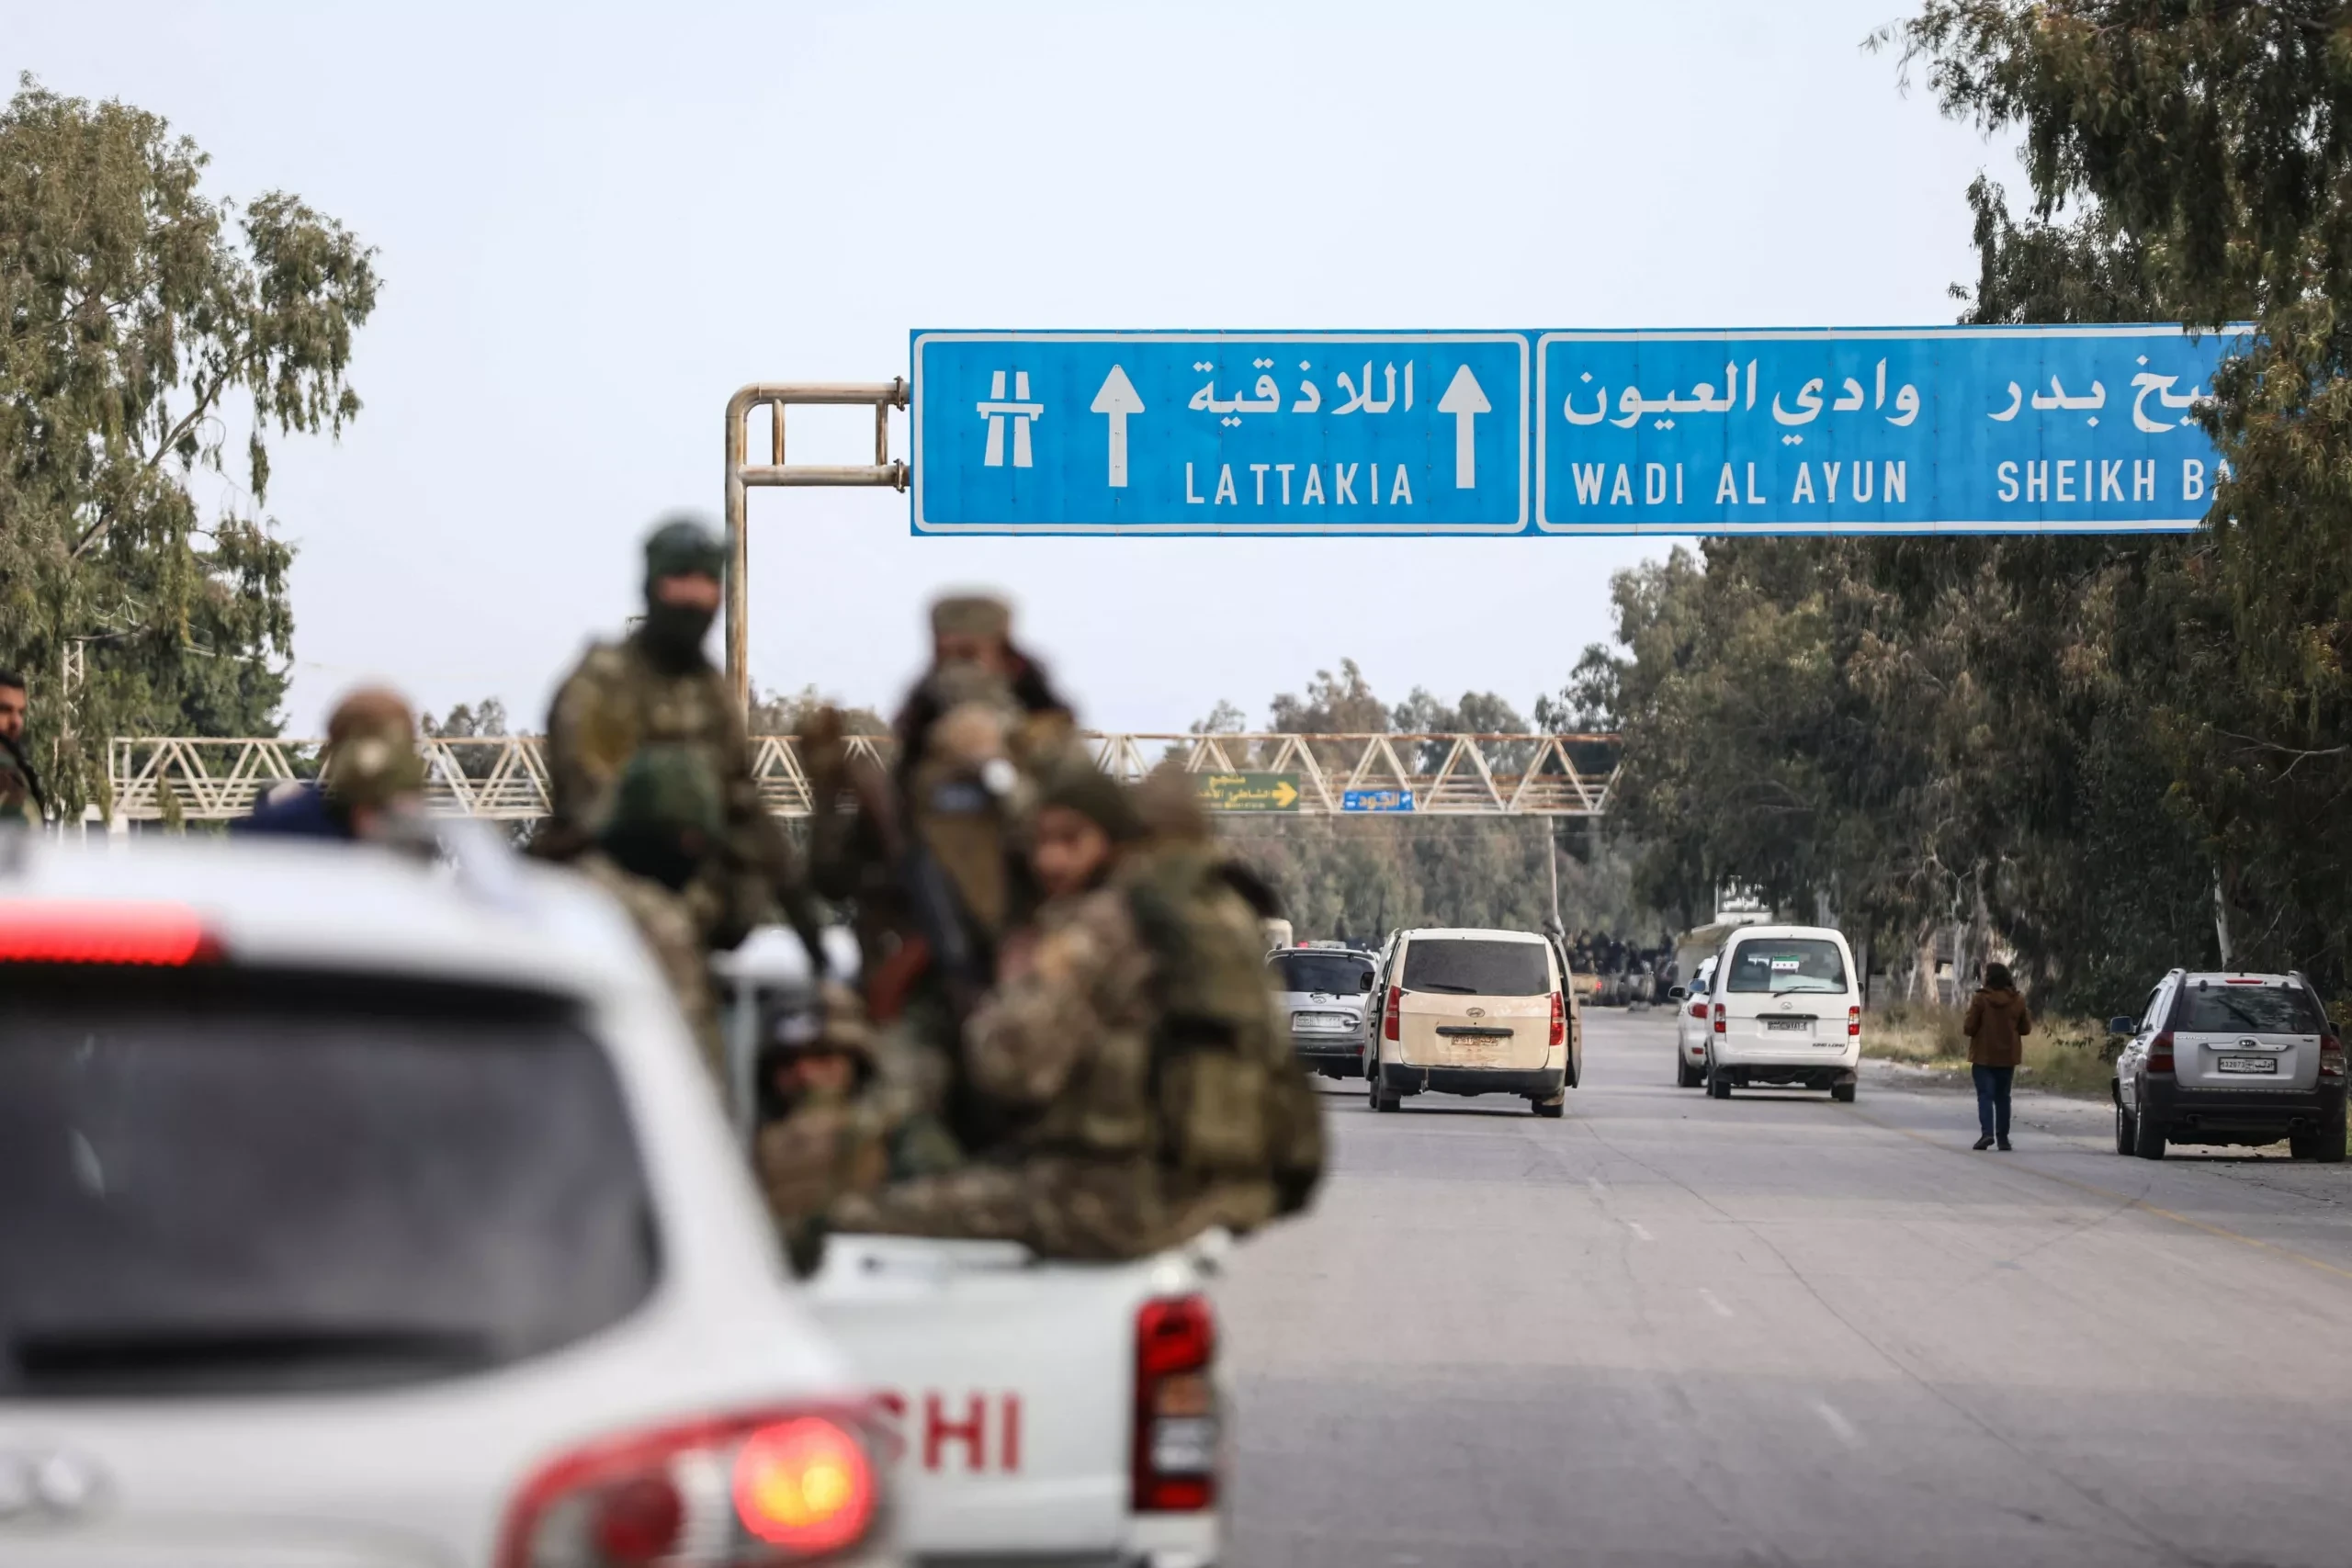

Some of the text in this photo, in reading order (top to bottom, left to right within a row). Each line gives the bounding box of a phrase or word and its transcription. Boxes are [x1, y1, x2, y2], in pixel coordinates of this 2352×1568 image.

[1187, 357, 1414, 428] اللاذقية
[1563, 355, 1921, 446] وادي العيون
[1987, 373, 2107, 428] بدر
[1185, 461, 1413, 506] LATTAKIA
[1571, 460, 1907, 506] WADI AL AYUN
[1996, 458, 2156, 503] SHEIKH
